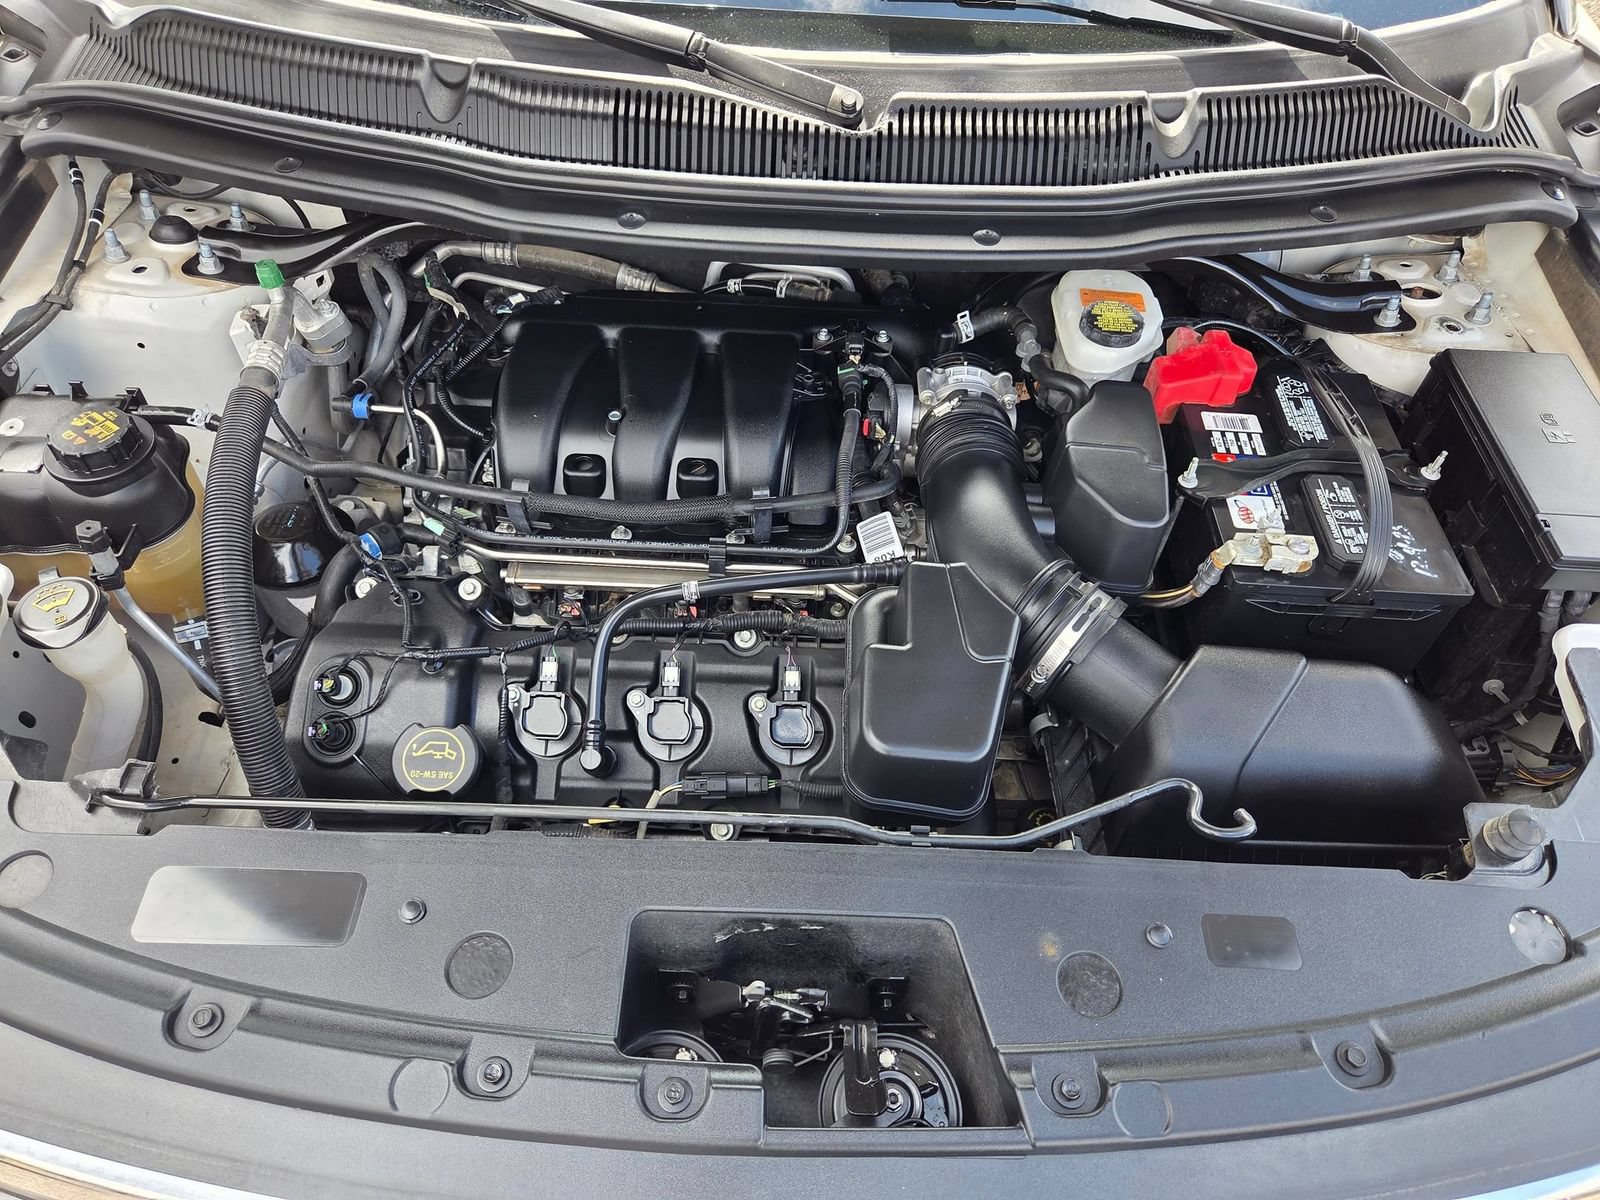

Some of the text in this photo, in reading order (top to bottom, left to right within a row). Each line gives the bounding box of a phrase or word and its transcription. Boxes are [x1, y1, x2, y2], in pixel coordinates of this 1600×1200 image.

[1314, 488, 1329, 510] POISON
[1325, 514, 1340, 540] DANGER
[410, 769, 453, 780] SAE 5W-20
